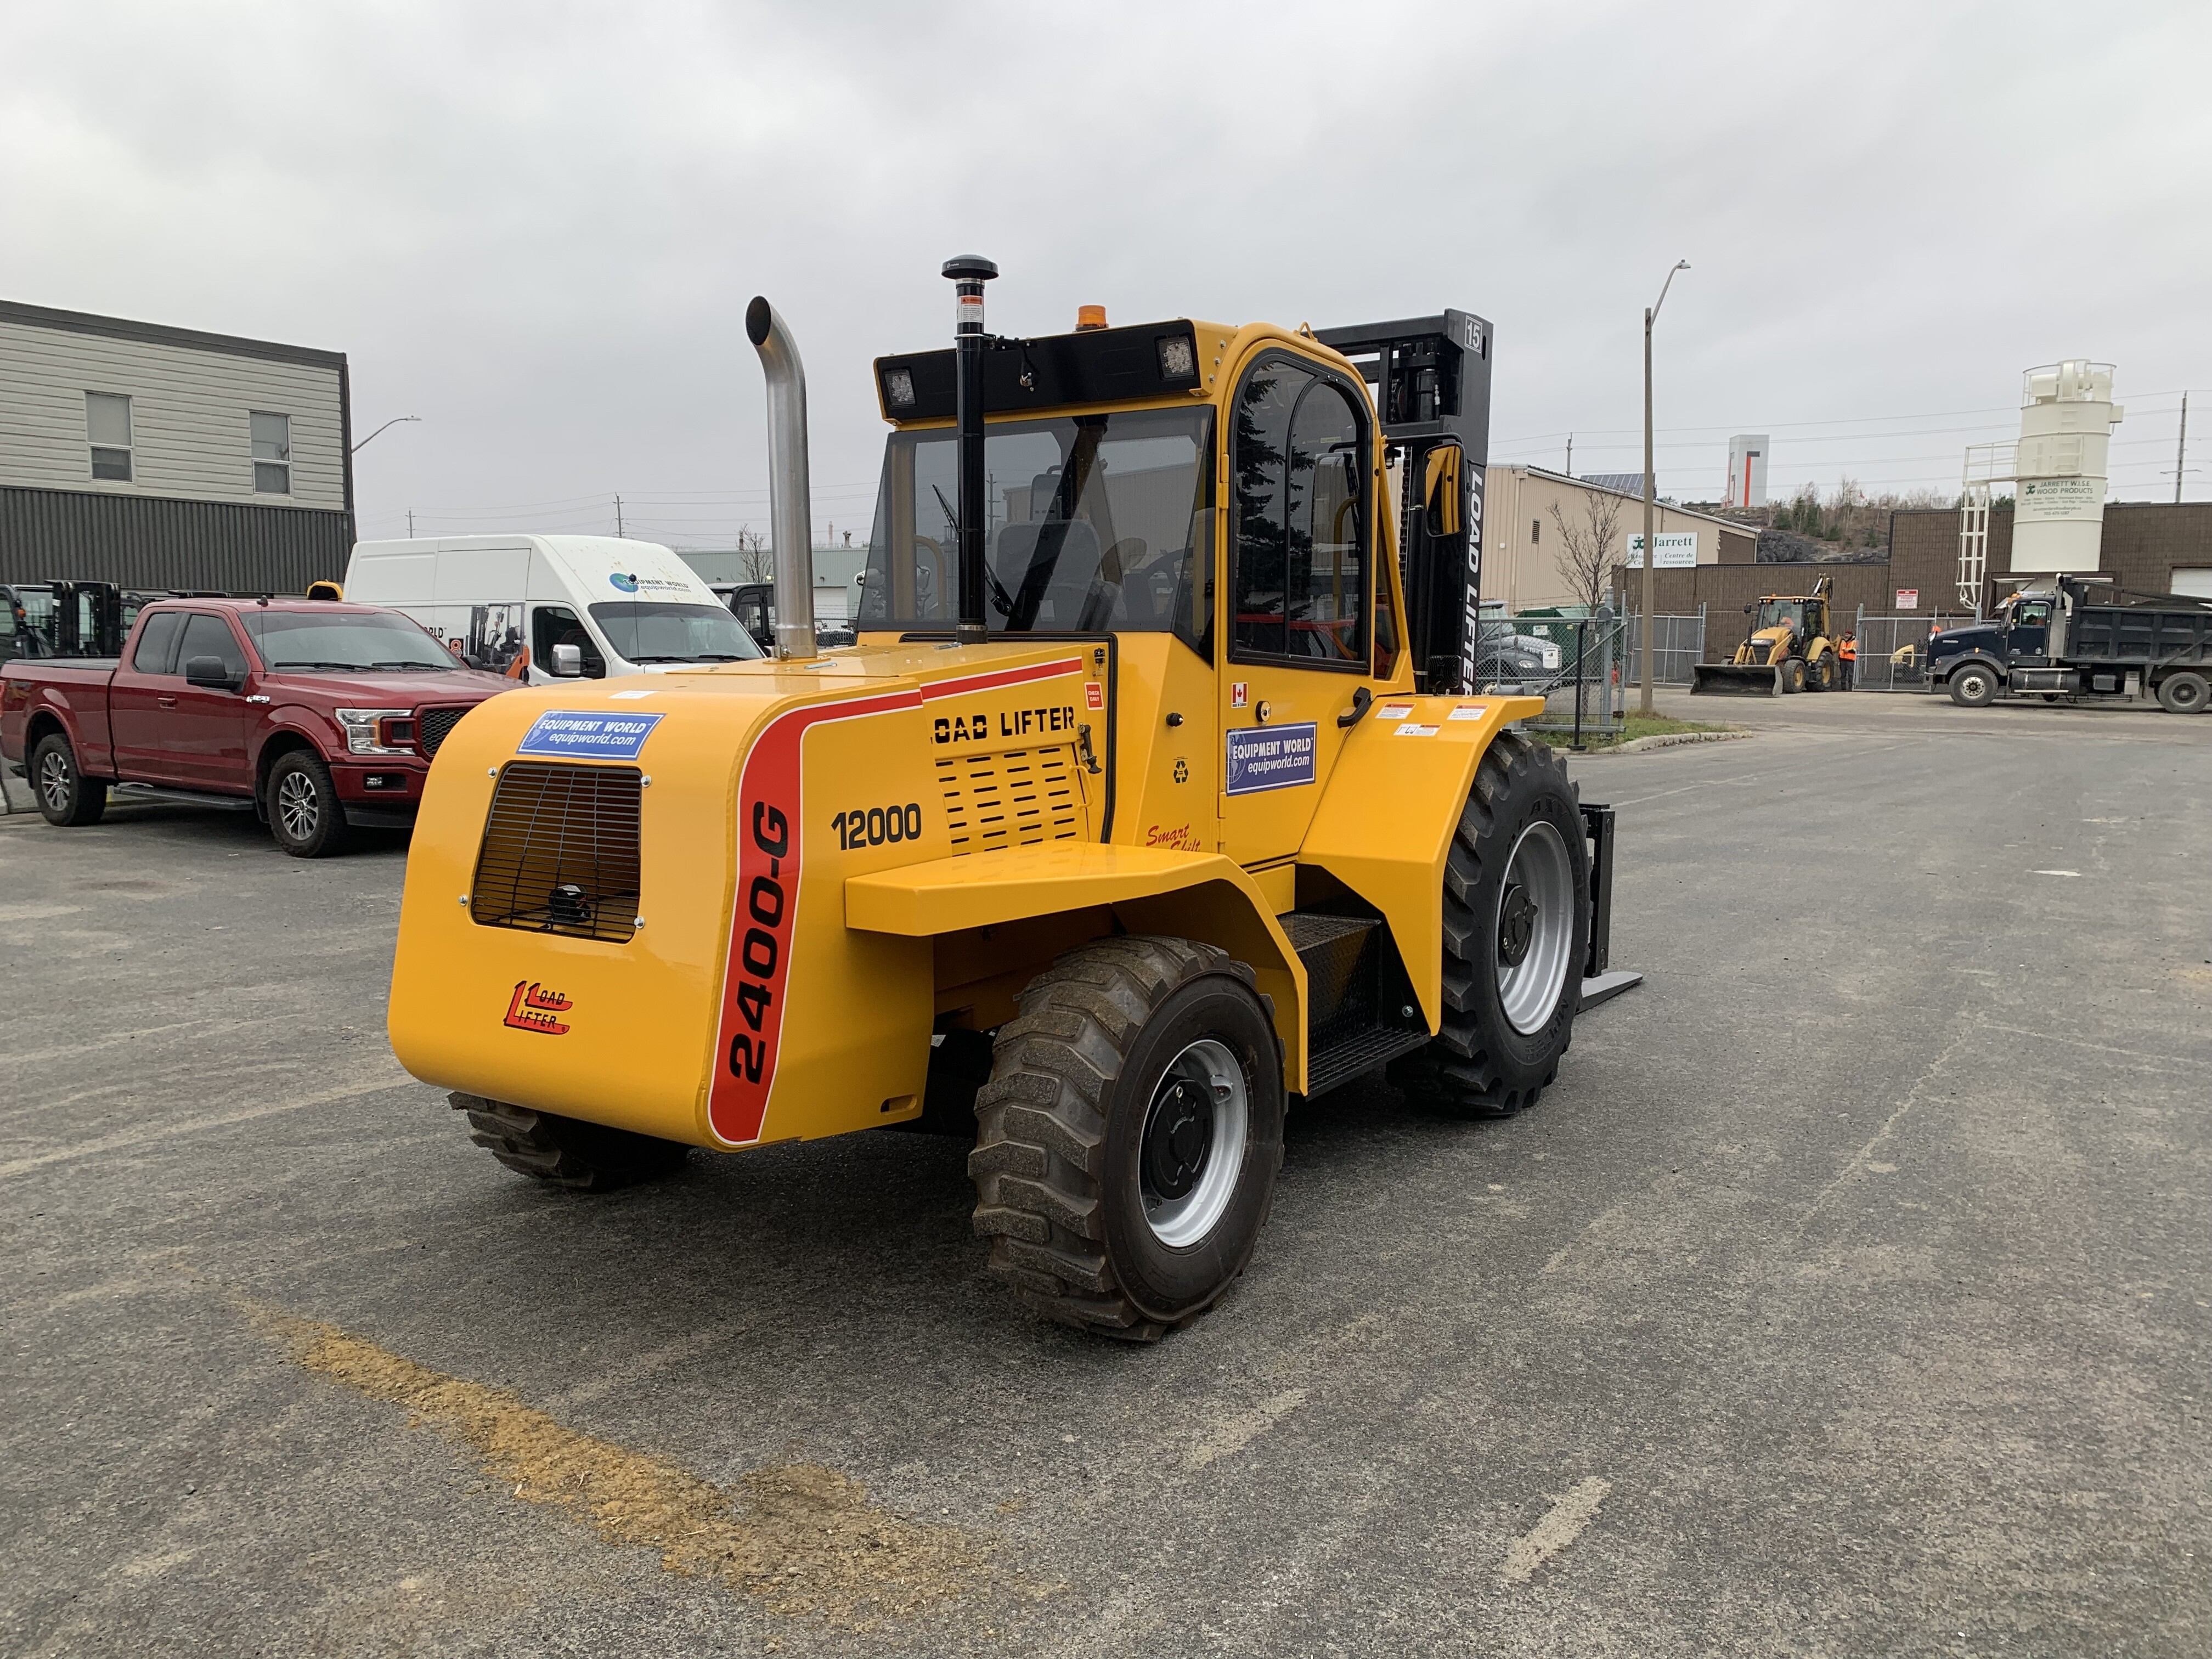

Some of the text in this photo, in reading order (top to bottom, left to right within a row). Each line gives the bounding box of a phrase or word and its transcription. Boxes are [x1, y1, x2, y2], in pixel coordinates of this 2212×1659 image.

[1468, 322, 1480, 348] 15
[1469, 470, 1482, 573] LOAD
[1654, 537, 1692, 548] Jarrett
[640, 585, 692, 593] equipworld.com
[538, 720, 603, 732] EQUIPMENT
[930, 706, 1075, 744] OAD LIFTER
[549, 732, 636, 746] equipworld.com
[1233, 741, 1280, 760] EQUIPMENT
[1248, 755, 1310, 775] equipworld.com
[831, 803, 922, 850] 12000
[1146, 823, 1189, 847] Smart
[729, 801, 788, 1085] 2400-G
[524, 983, 573, 1011] LOAD
